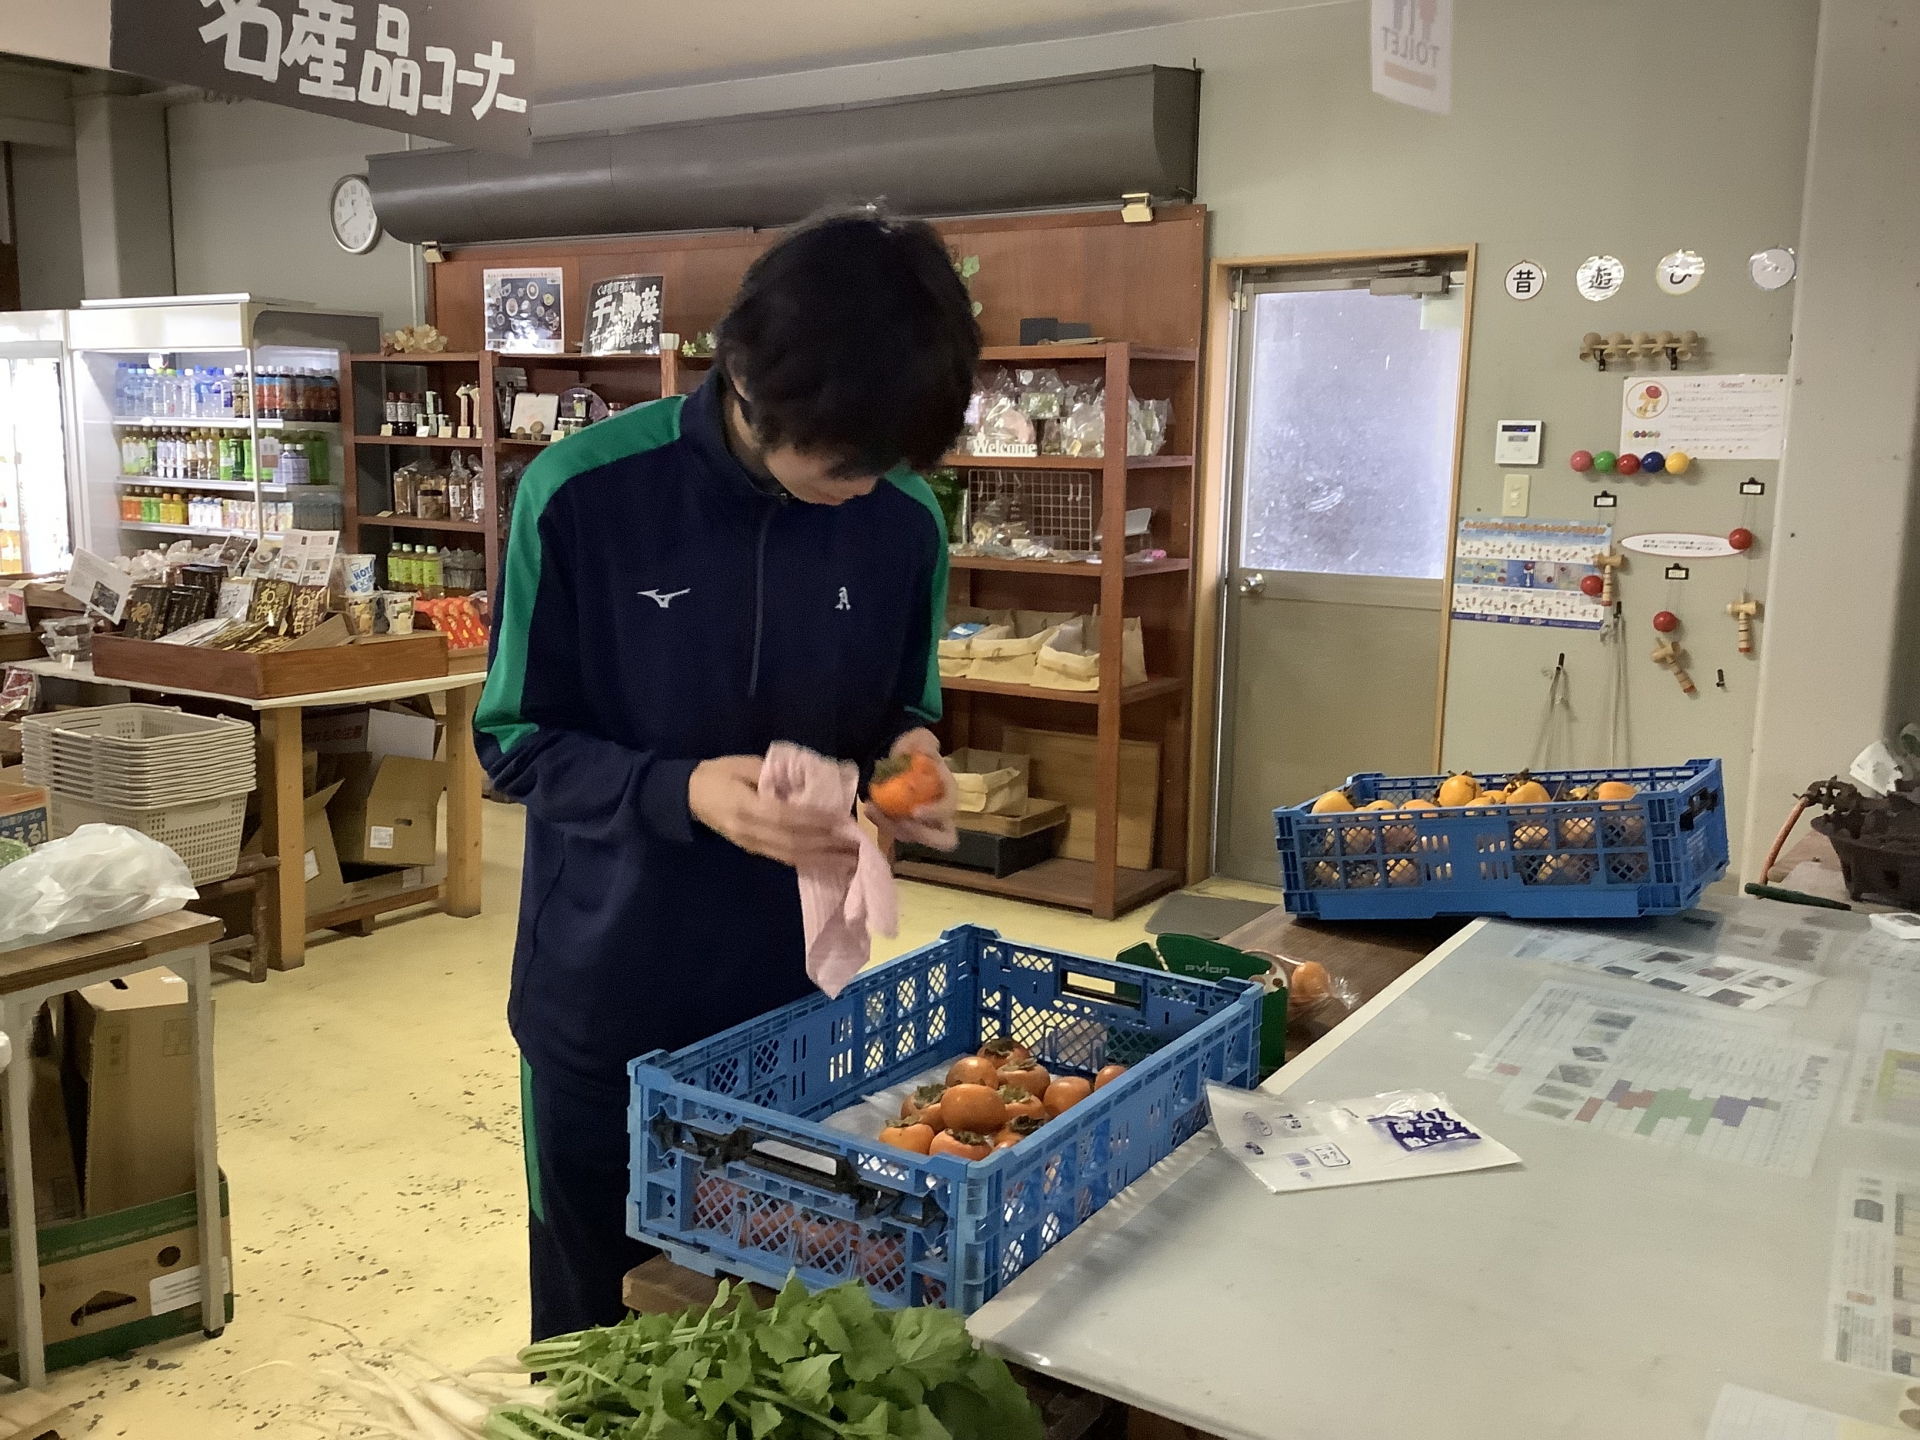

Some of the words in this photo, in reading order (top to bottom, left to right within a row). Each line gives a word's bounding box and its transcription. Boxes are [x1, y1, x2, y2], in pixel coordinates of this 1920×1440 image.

[198, 0, 527, 121] 名産品コーナー
[1513, 269, 1536, 293] 昔
[1589, 266, 1613, 290] 遊
[973, 439, 1038, 456] Welcome
